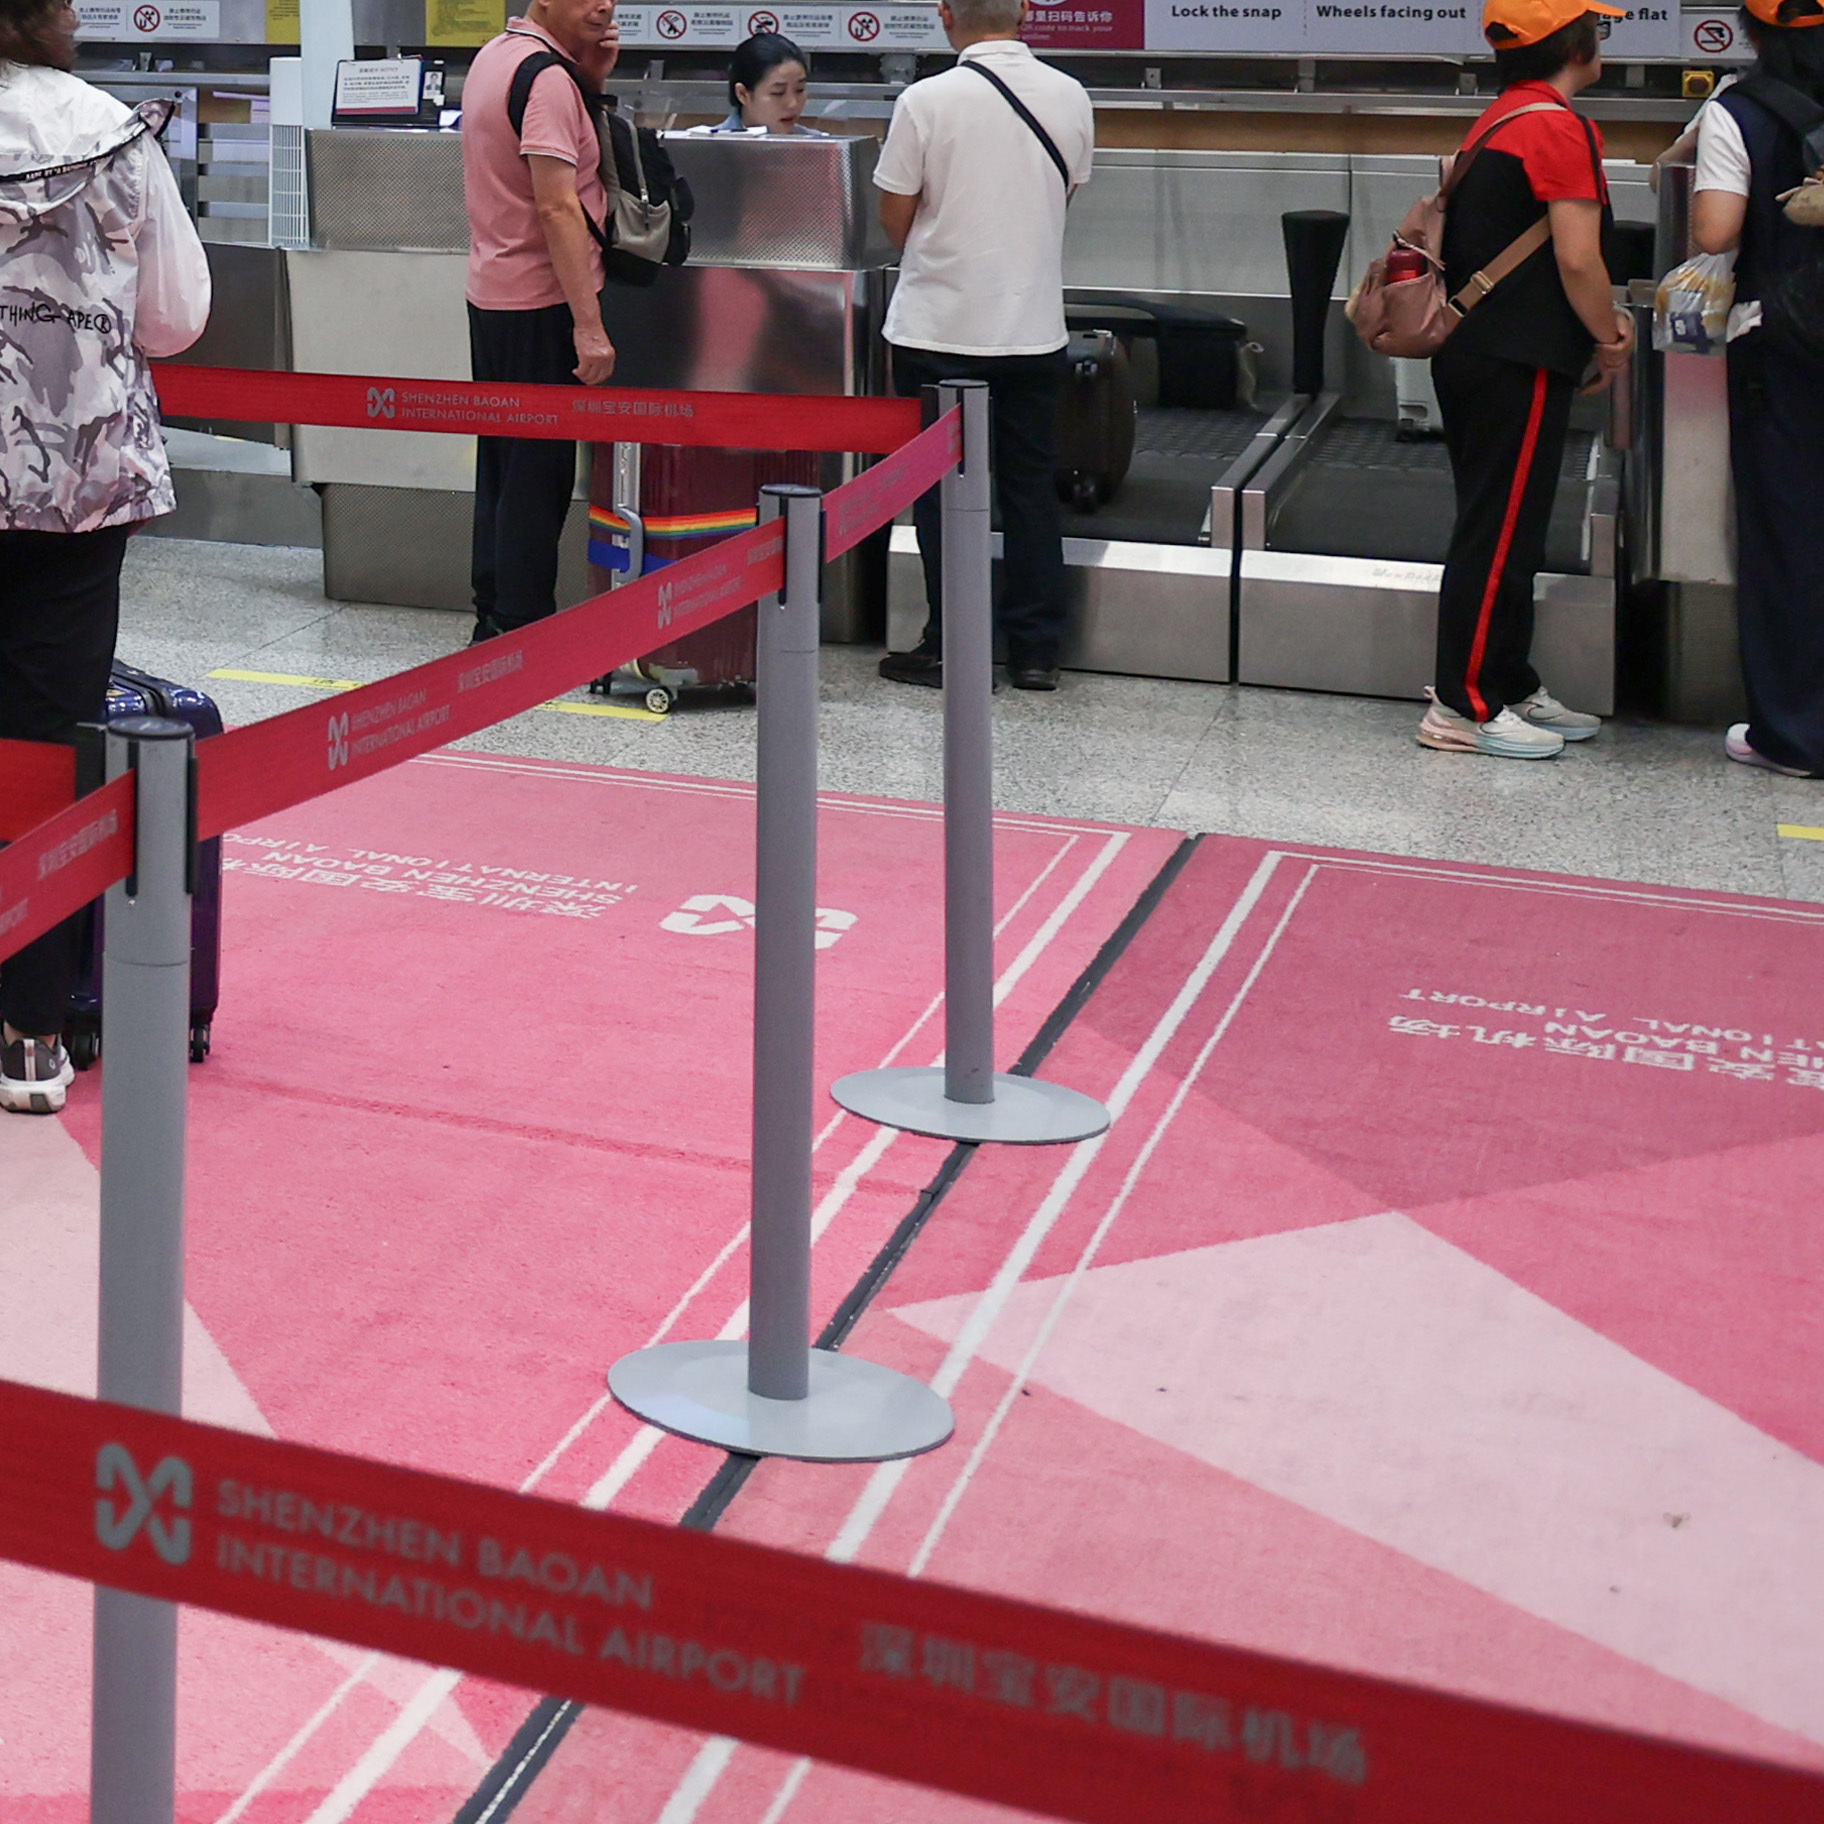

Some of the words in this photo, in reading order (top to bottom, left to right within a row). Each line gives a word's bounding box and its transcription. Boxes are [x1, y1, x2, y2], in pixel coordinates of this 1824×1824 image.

[1172, 6, 1208, 18] Lock
[1213, 6, 1239, 18] the
[1242, 8, 1281, 20] snap
[1317, 6, 1376, 18] Wheels
[1381, 6, 1433, 20] facing
[1437, 7, 1466, 18] out
[1639, 8, 1668, 21] flat
[401, 392, 471, 407] SHENZHEN
[473, 396, 520, 409] BAOAN
[401, 408, 503, 423] INTERNATIONAL
[506, 413, 559, 425] AIRPORT
[572, 399, 694, 417] 深圳宝安国际机场
[223, 833, 330, 853] AIRPO
[262, 852, 394, 877] BAOAN
[222, 857, 606, 918] 深圳宝安国际
[406, 867, 622, 905] SHENZHEN
[1400, 989, 1606, 1021] AIRPORT
[1545, 1021, 1718, 1055] BAOAN
[216, 1479, 462, 1568] SHENZHEN
[478, 1535, 652, 1611] BAOAN
[216, 1534, 585, 1656] INTERNATIONAL
[599, 1625, 805, 1705] AIRPORT
[859, 1620, 1367, 1786] 深圳宝安国际机场
